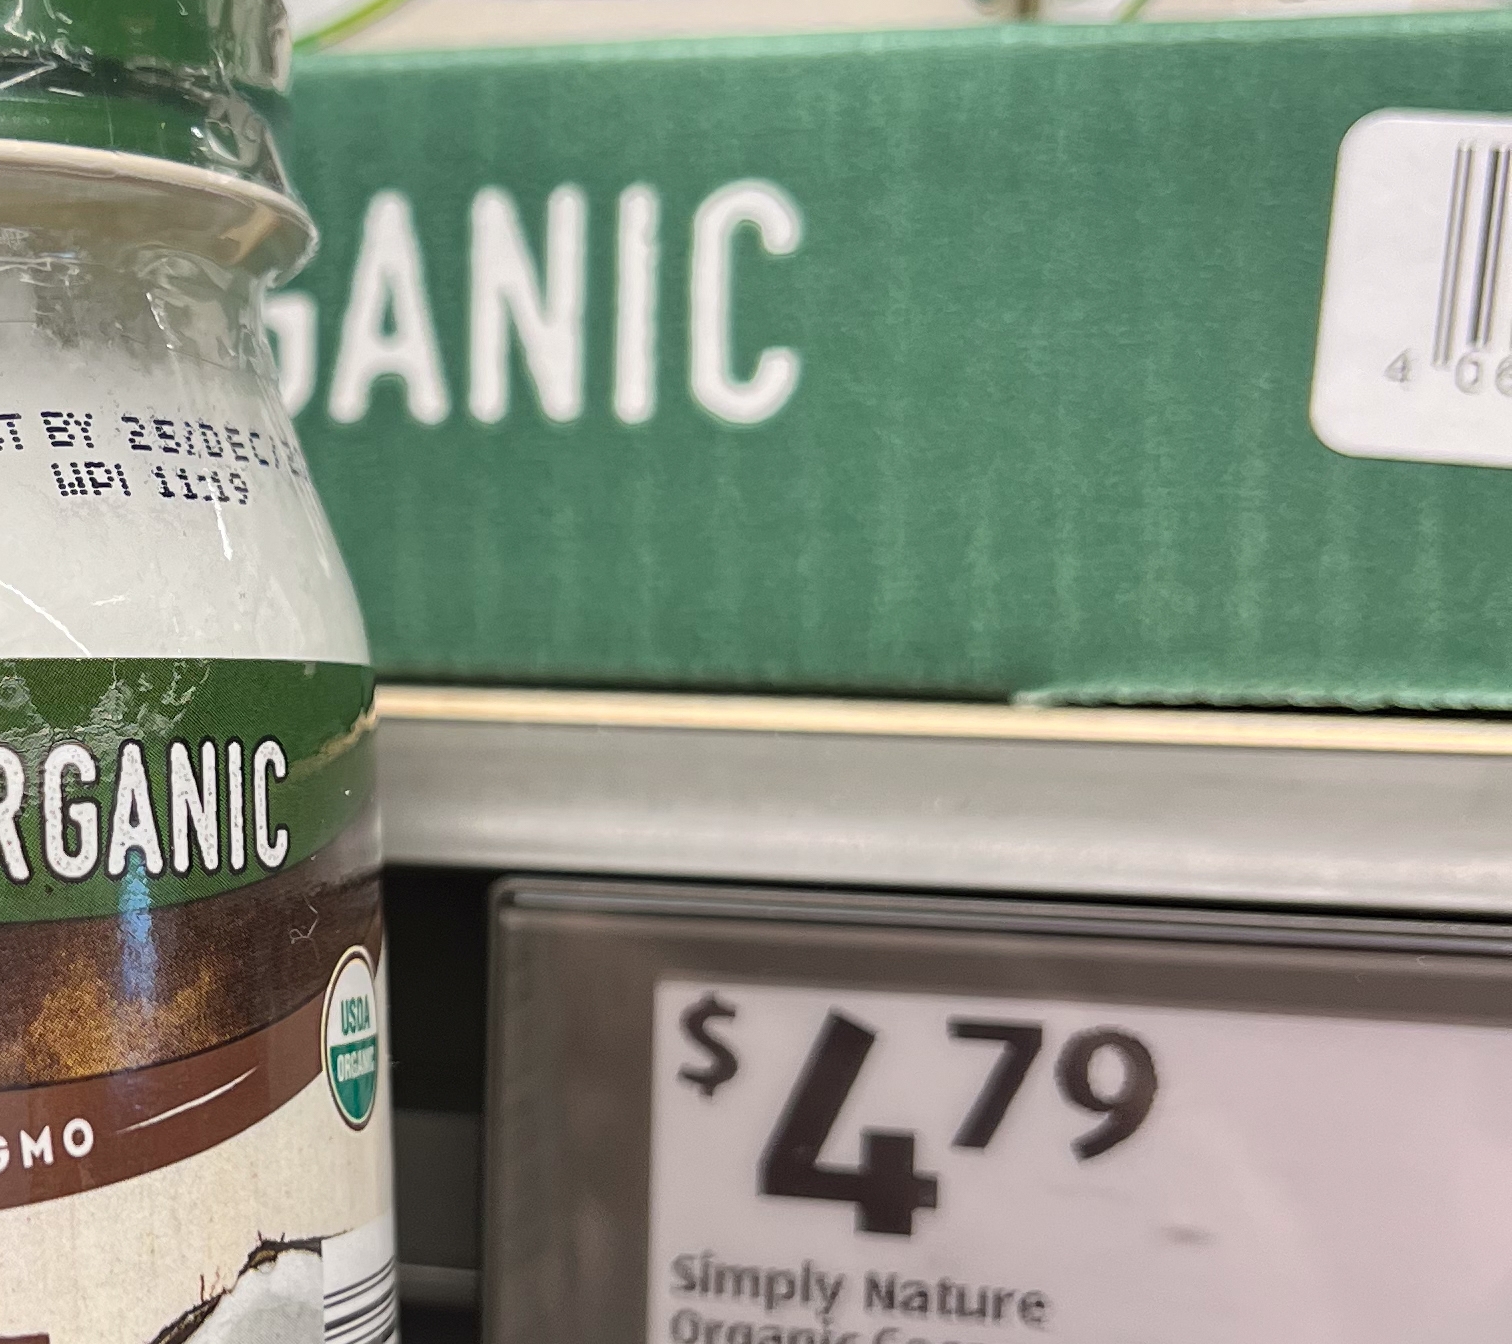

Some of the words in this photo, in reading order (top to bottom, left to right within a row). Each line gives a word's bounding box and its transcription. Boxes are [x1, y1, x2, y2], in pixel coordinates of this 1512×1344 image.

[262, 179, 802, 424] ANIC
[40, 411, 94, 449] BY
[341, 993, 372, 1036] USDA
[669, 1251, 845, 1318] Simply
[863, 1270, 1052, 1328] Nature
